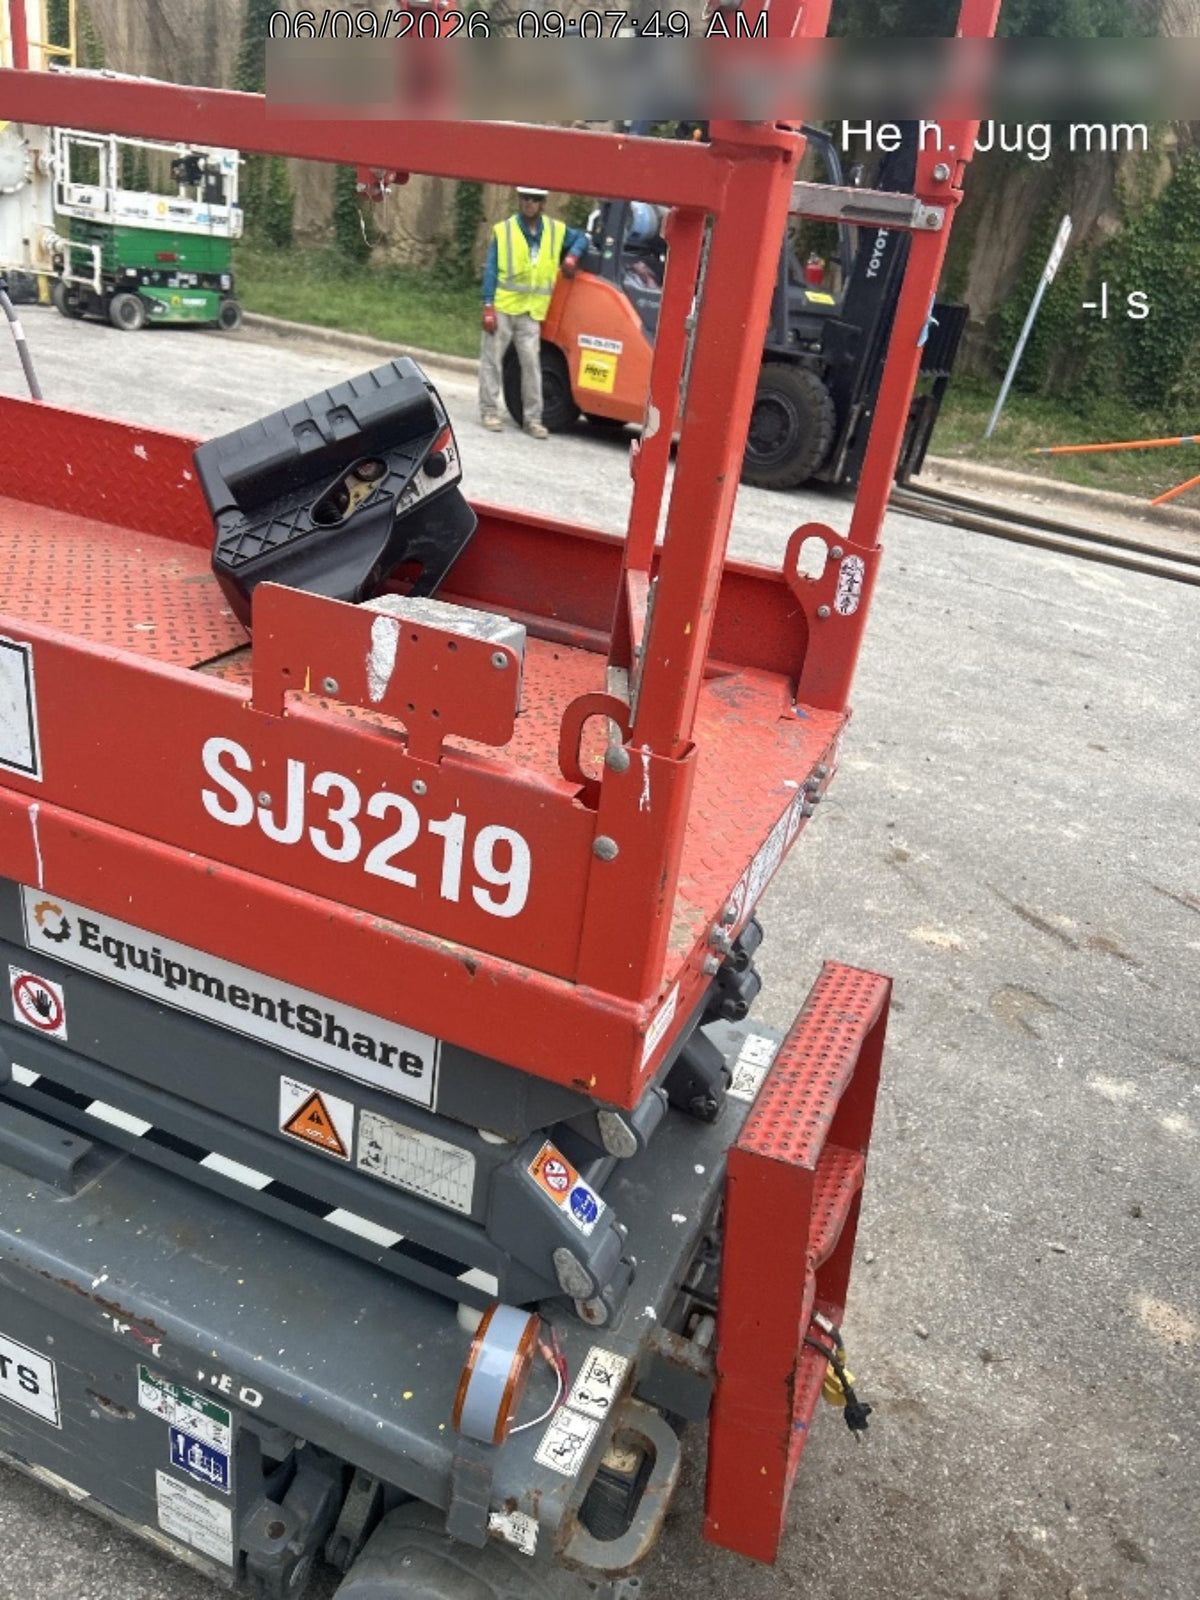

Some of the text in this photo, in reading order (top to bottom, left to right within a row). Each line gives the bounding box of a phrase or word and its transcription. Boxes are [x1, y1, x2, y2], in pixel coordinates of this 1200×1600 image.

[866, 228, 889, 278] TOYOT
[202, 737, 532, 918] SJ3219
[78, 917, 424, 1078] EquipmentShare
